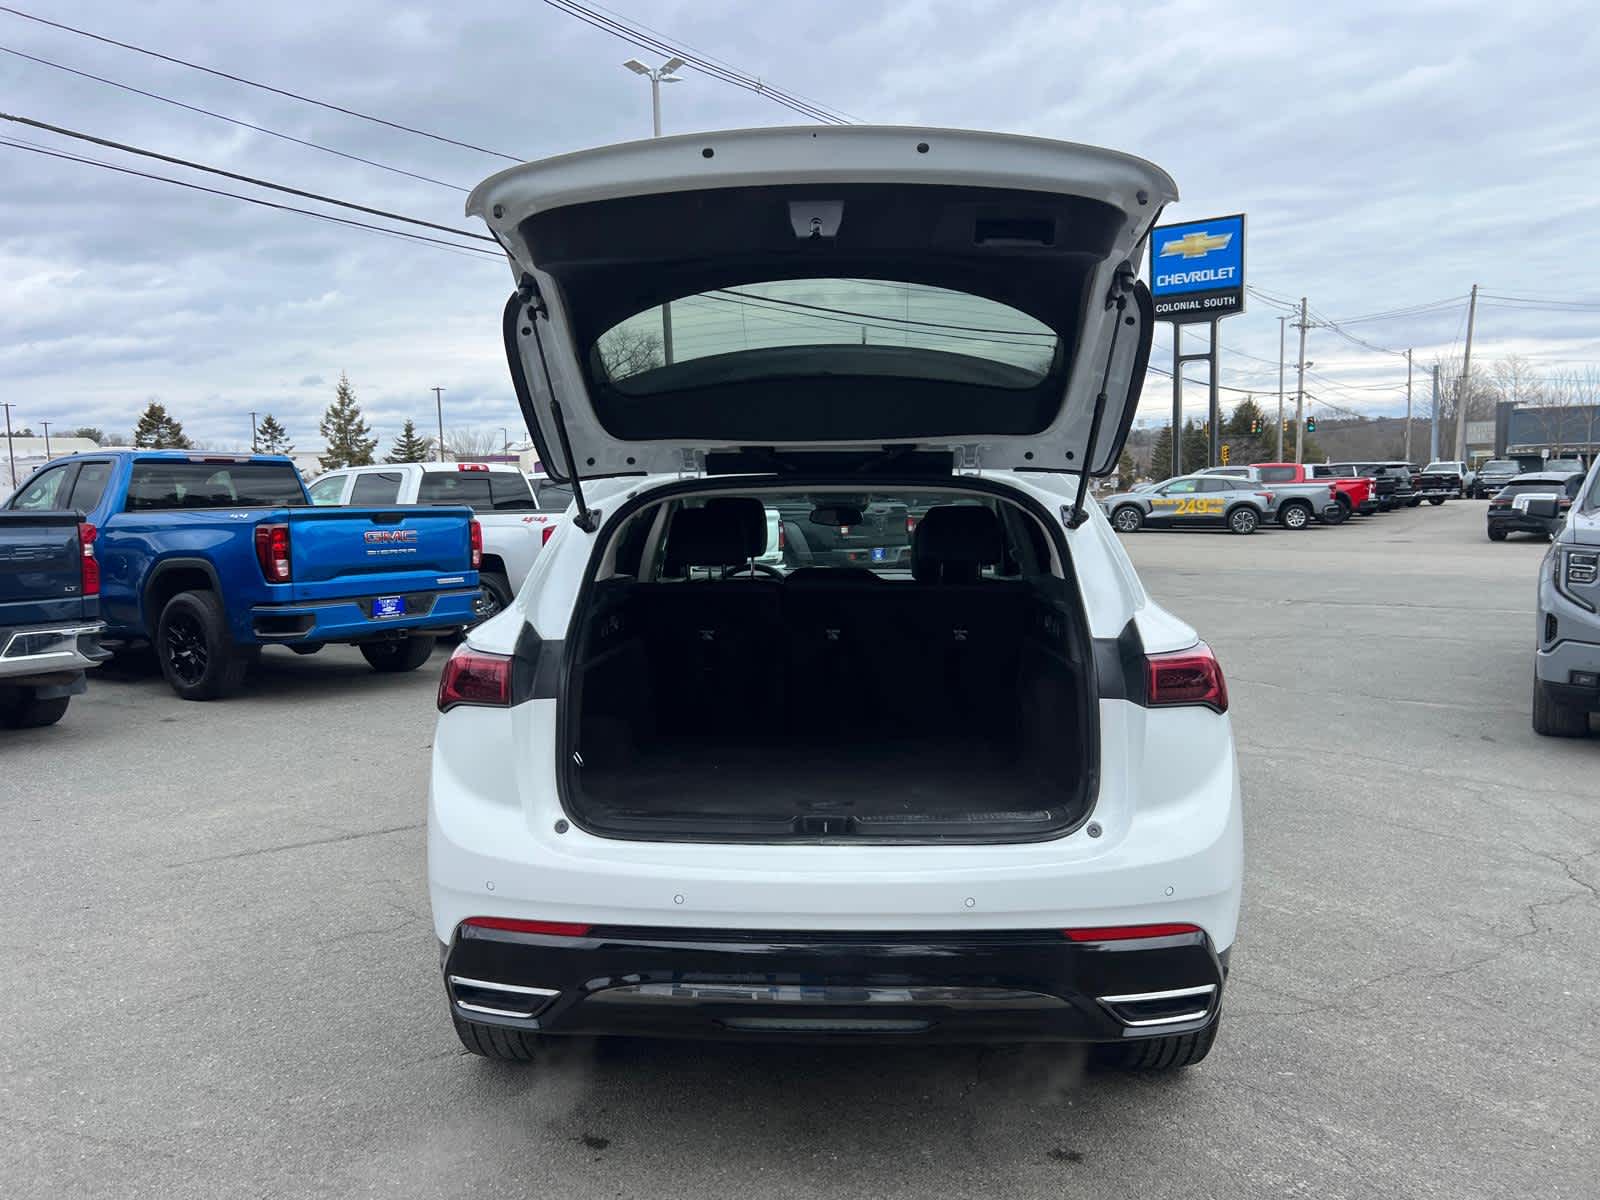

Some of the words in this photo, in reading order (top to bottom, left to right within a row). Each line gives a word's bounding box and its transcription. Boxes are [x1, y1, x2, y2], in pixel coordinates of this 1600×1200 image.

[1157, 266, 1235, 287] CHEVROLET
[1155, 300, 1201, 313] COLONIAL
[1204, 296, 1236, 308] SOUTH
[1175, 498, 1208, 514] 249
[364, 530, 417, 544] GMC
